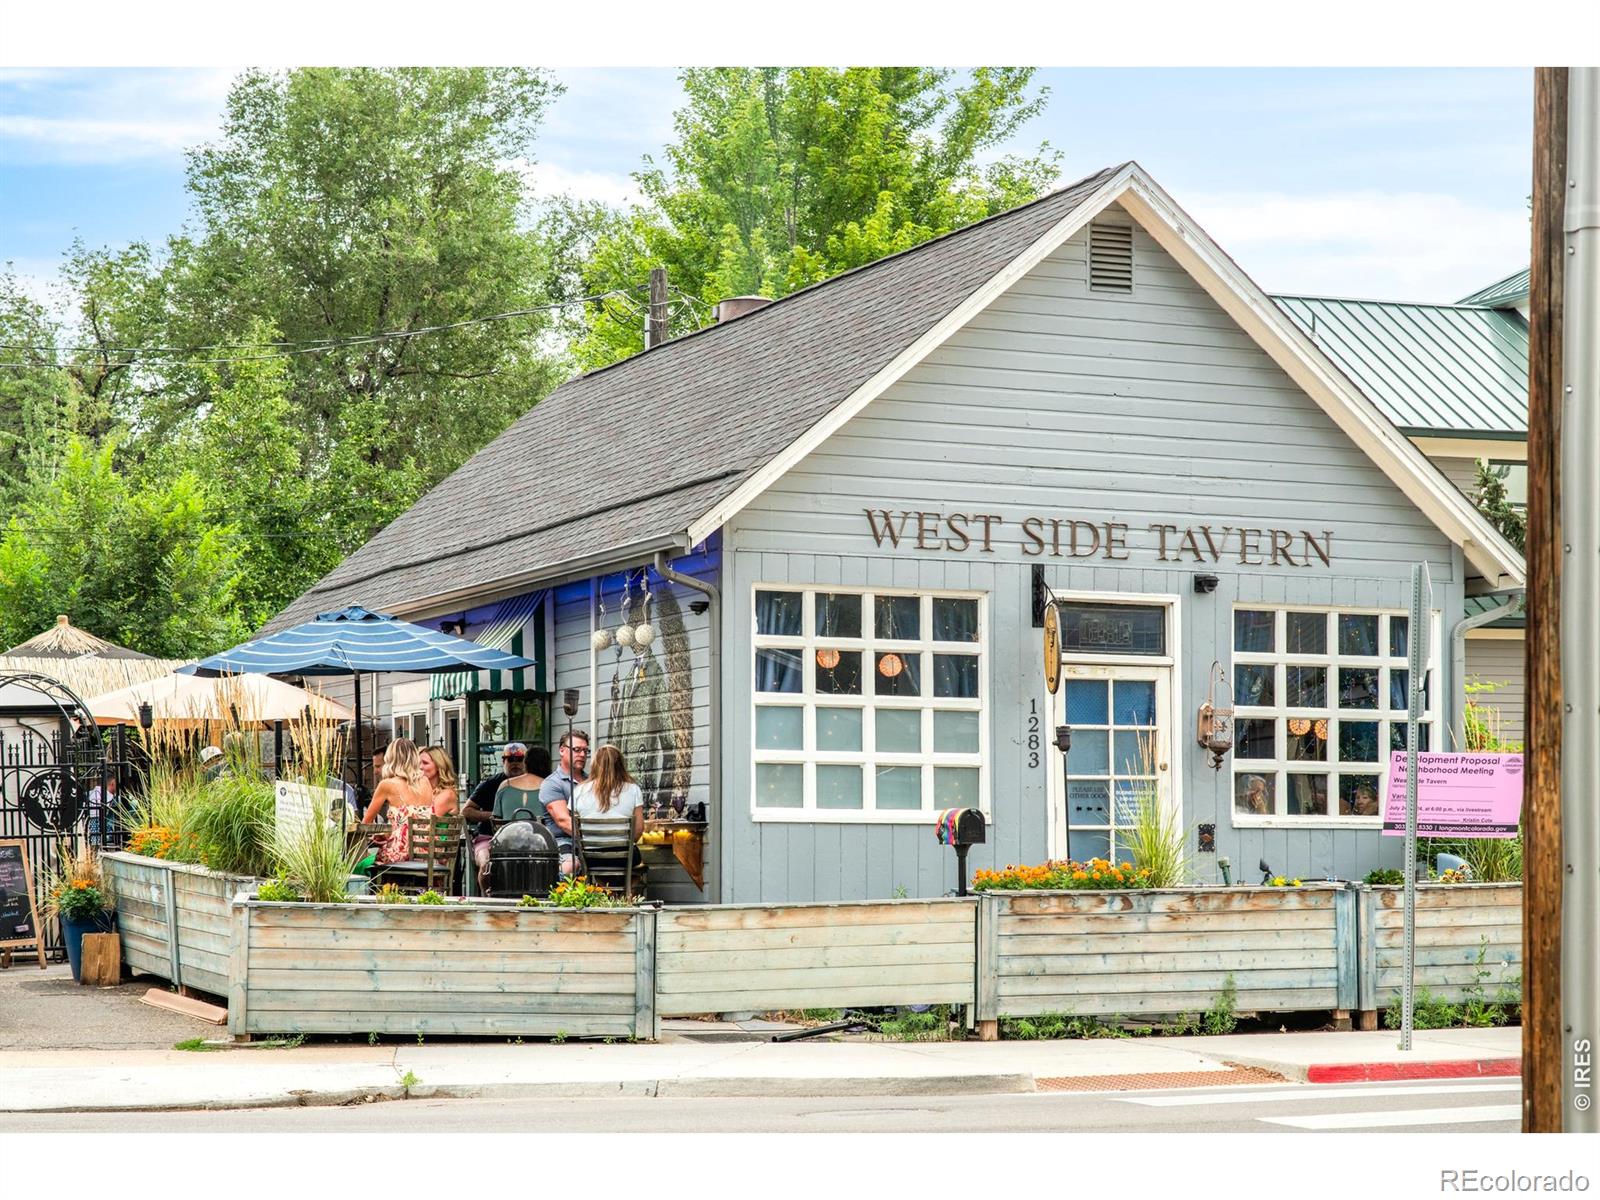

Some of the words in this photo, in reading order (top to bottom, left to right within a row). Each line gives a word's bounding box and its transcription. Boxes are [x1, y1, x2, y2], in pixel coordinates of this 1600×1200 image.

[862, 508, 1001, 552] WEST
[1021, 516, 1130, 560] SIDE
[1149, 523, 1334, 568] TAVERN
[1028, 698, 1040, 769] 1283
[1395, 754, 1459, 765] Delopment
[1460, 756, 1501, 765] Proposal
[1398, 766, 1459, 774] Nehborhood
[1460, 766, 1495, 776] Meeting
